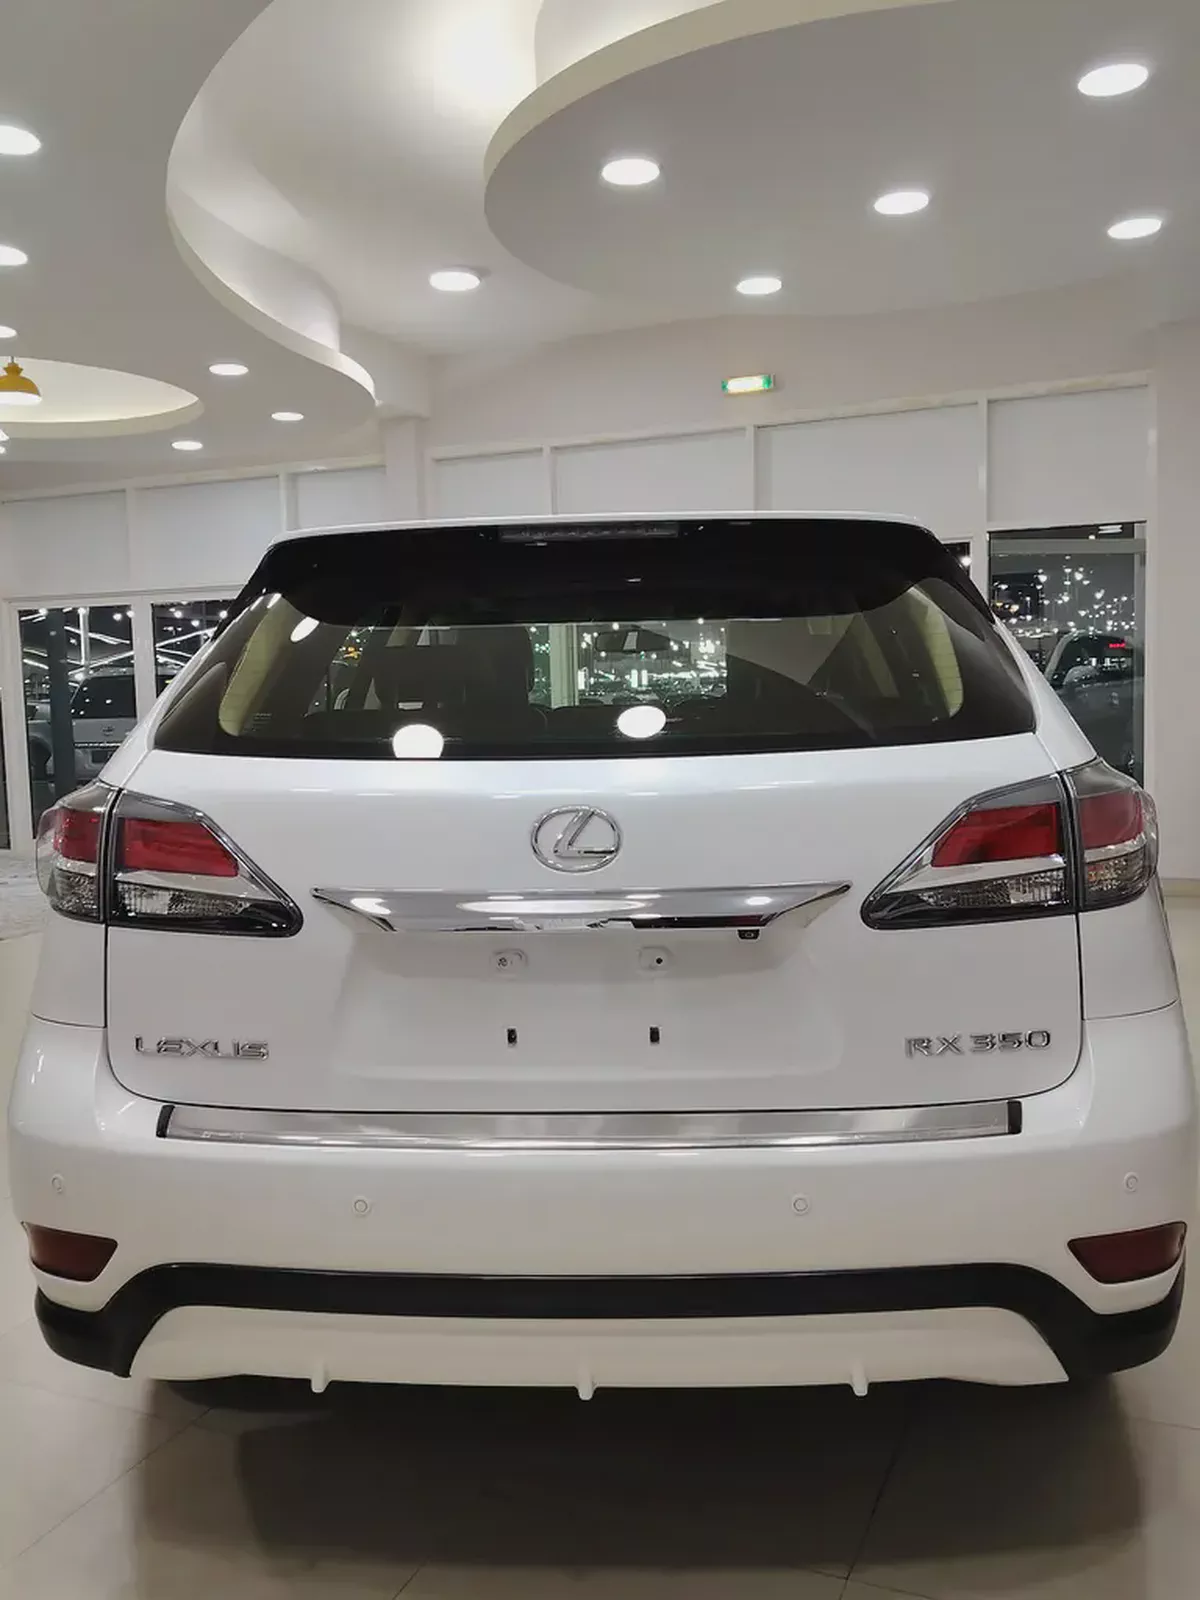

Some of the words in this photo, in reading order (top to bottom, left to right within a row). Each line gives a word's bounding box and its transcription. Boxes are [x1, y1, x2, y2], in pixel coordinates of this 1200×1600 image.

[134, 1035, 270, 1060] LEXUS
[905, 1034, 964, 1059] RX
[970, 1030, 1051, 1052] 350
